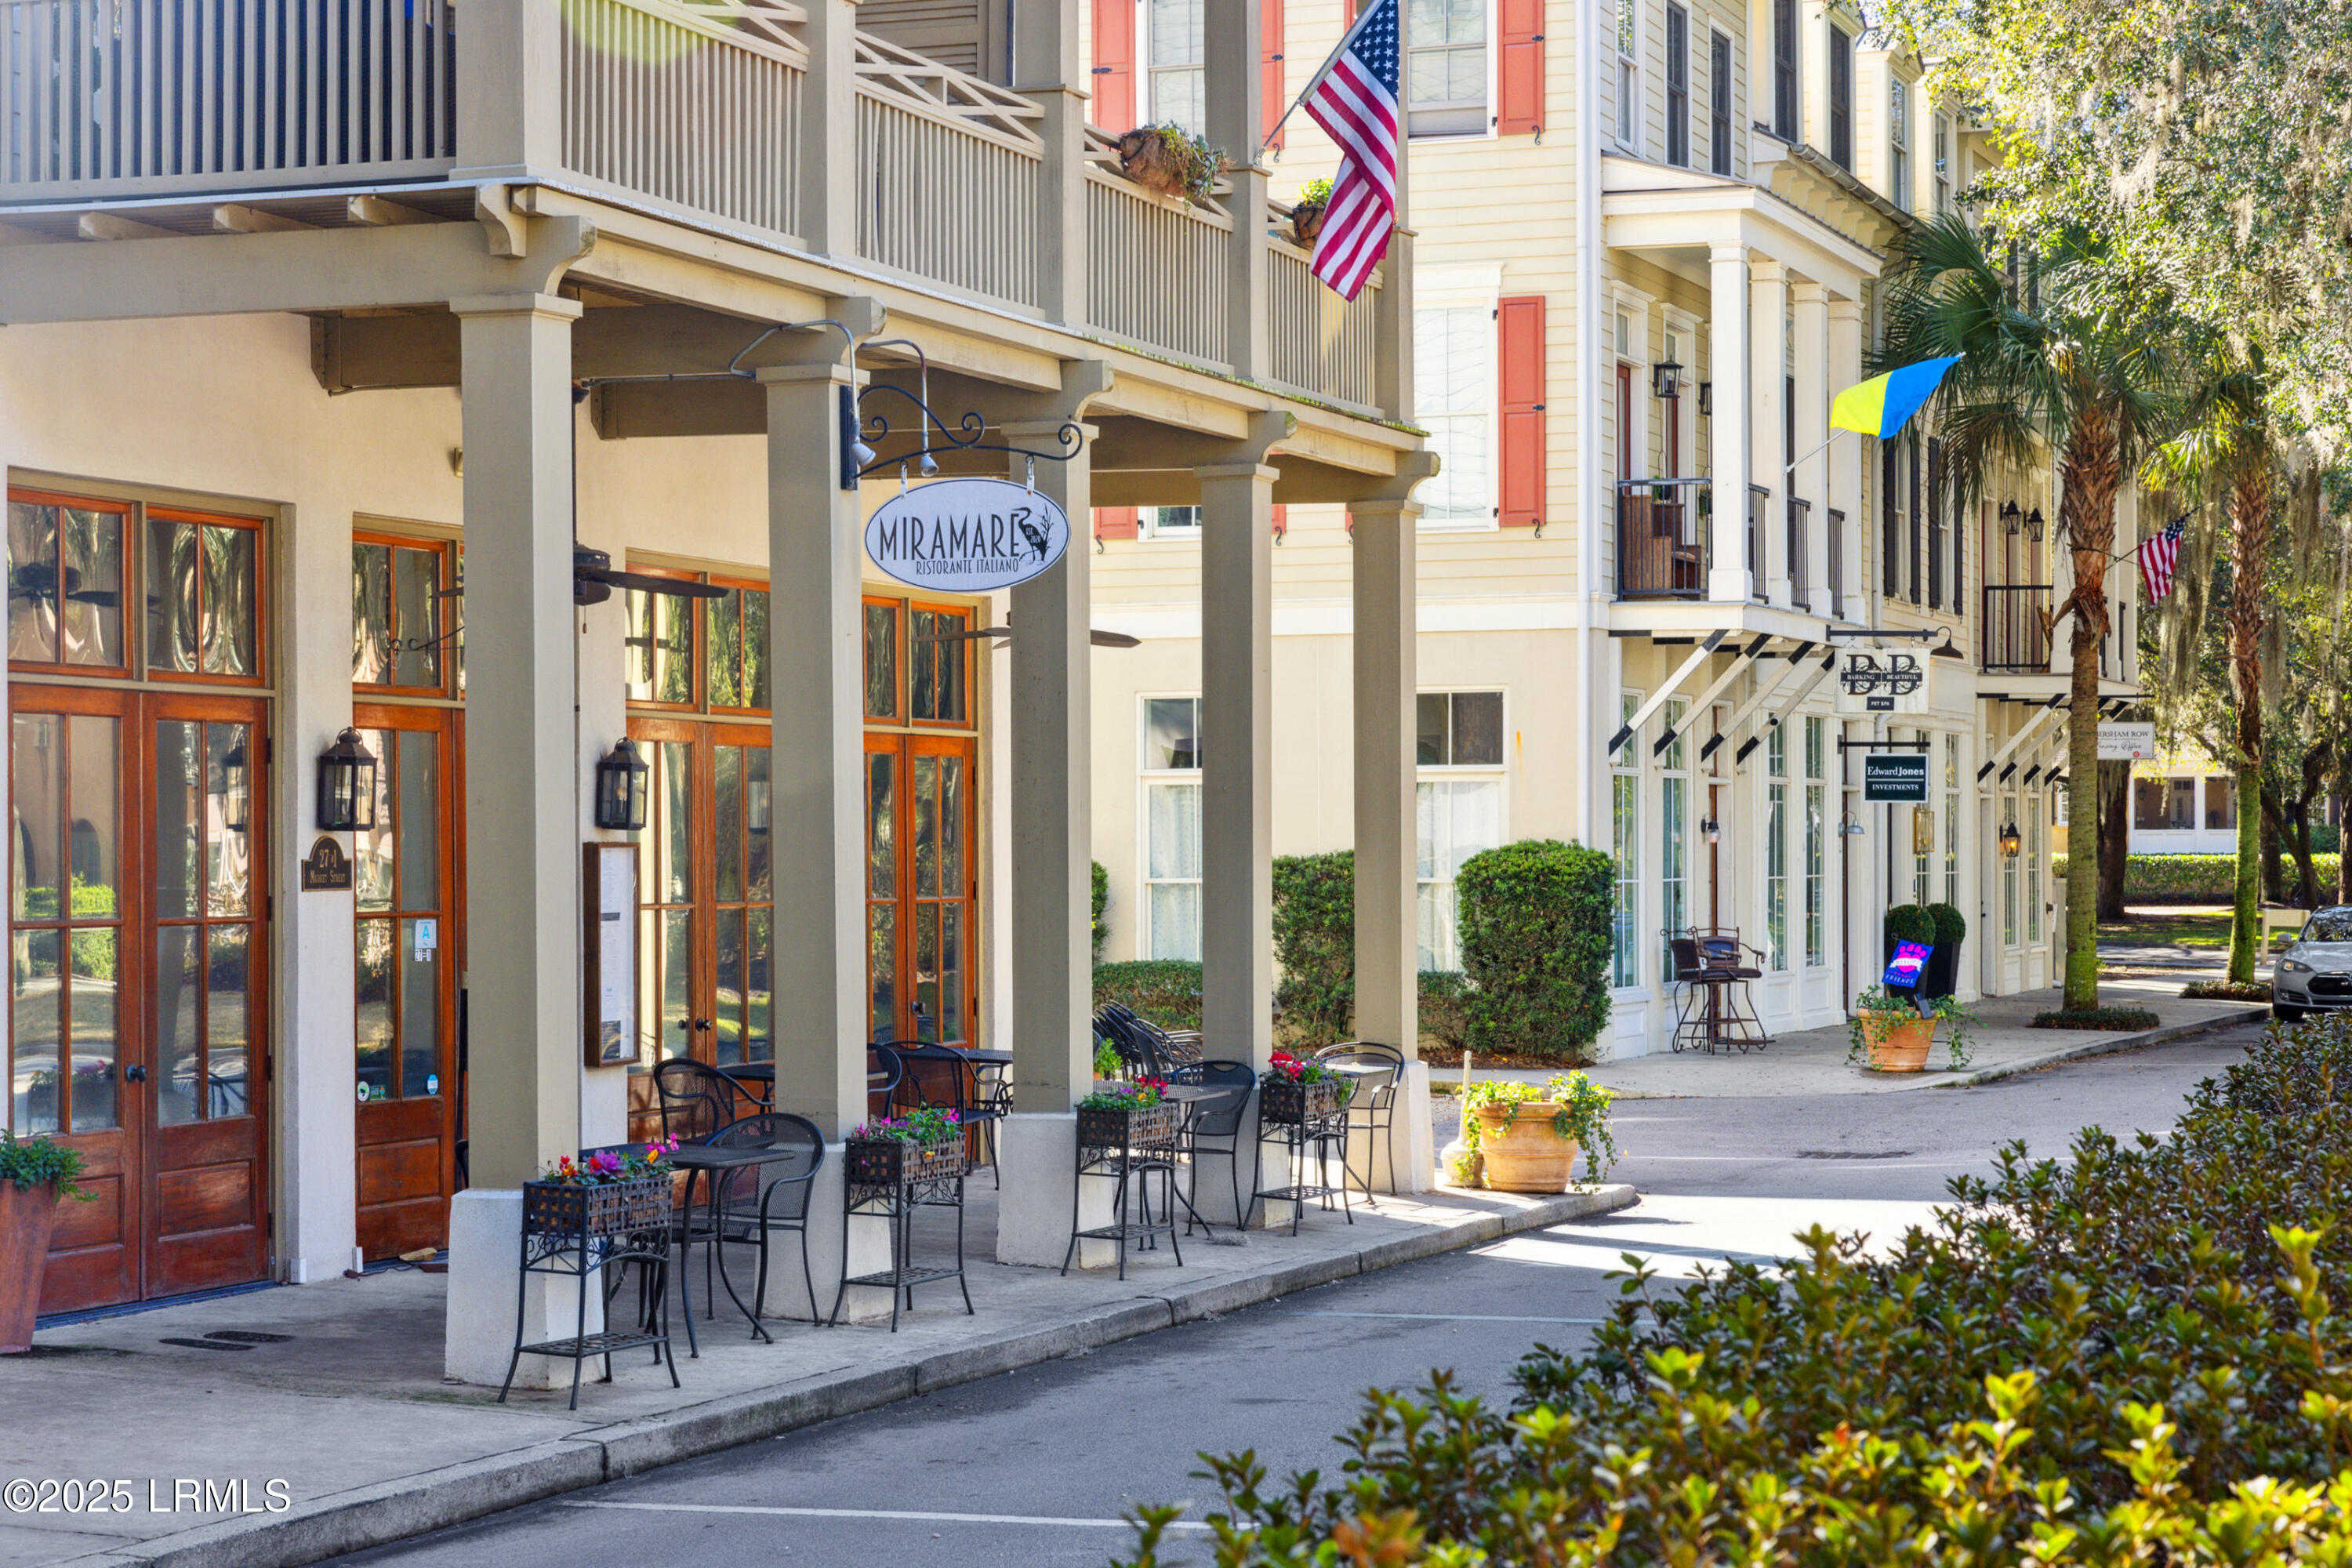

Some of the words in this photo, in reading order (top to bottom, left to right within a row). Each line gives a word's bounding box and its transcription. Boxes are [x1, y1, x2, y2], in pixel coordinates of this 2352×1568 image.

[880, 514, 1019, 561] MIRAMARE
[916, 559, 972, 575] RISTORANTE
[977, 557, 1018, 573] ITALIANO
[422, 925, 430, 939] A
